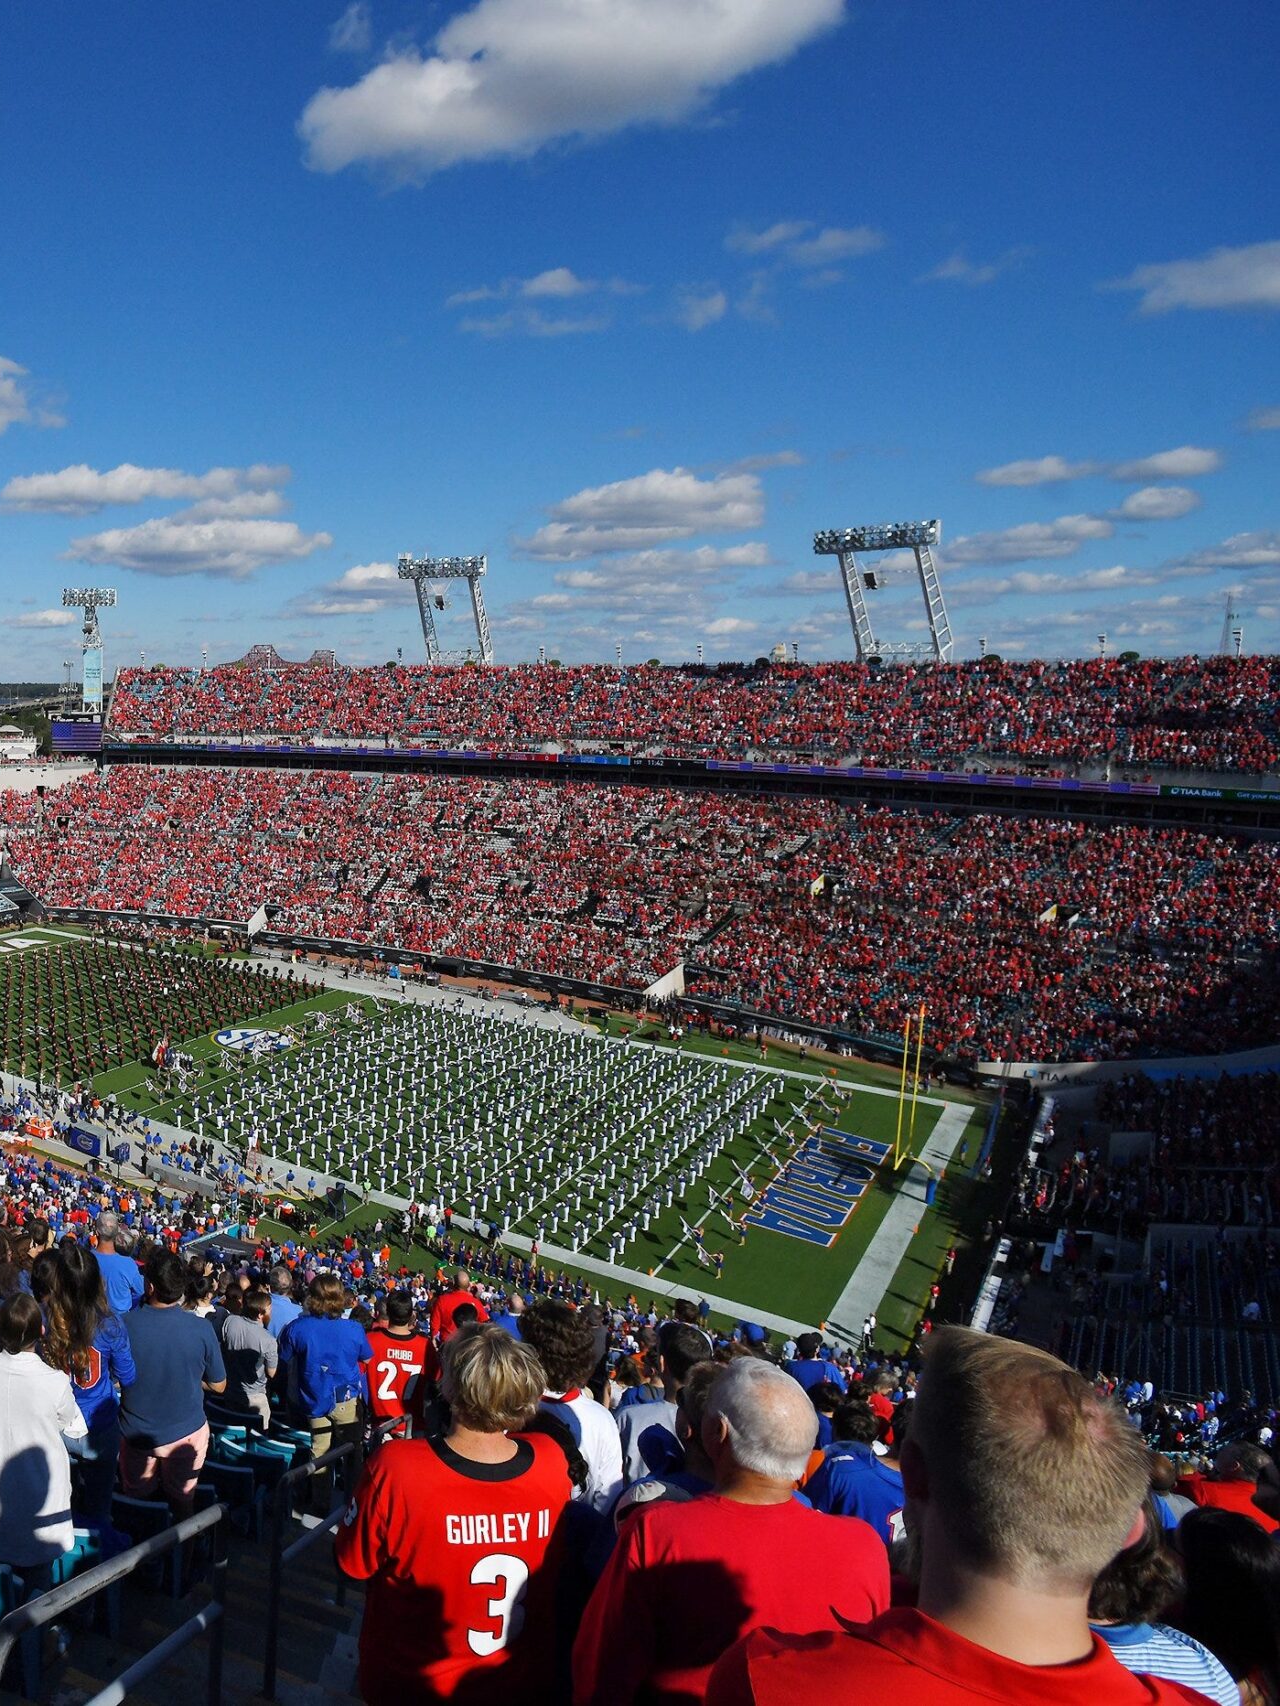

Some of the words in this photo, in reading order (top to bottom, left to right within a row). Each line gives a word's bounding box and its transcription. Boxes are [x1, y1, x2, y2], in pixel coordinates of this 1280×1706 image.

[1181, 788, 1200, 796] TIAA
[1201, 789, 1222, 797] Bank
[1038, 1071, 1070, 1084] TIAA
[740, 1123, 893, 1248] FLORIDA
[386, 1347, 414, 1362] CHUBB
[376, 1360, 423, 1401] 27
[446, 1511, 531, 1545] GURLEY
[537, 1508, 550, 1539] II
[467, 1553, 529, 1657] 3
